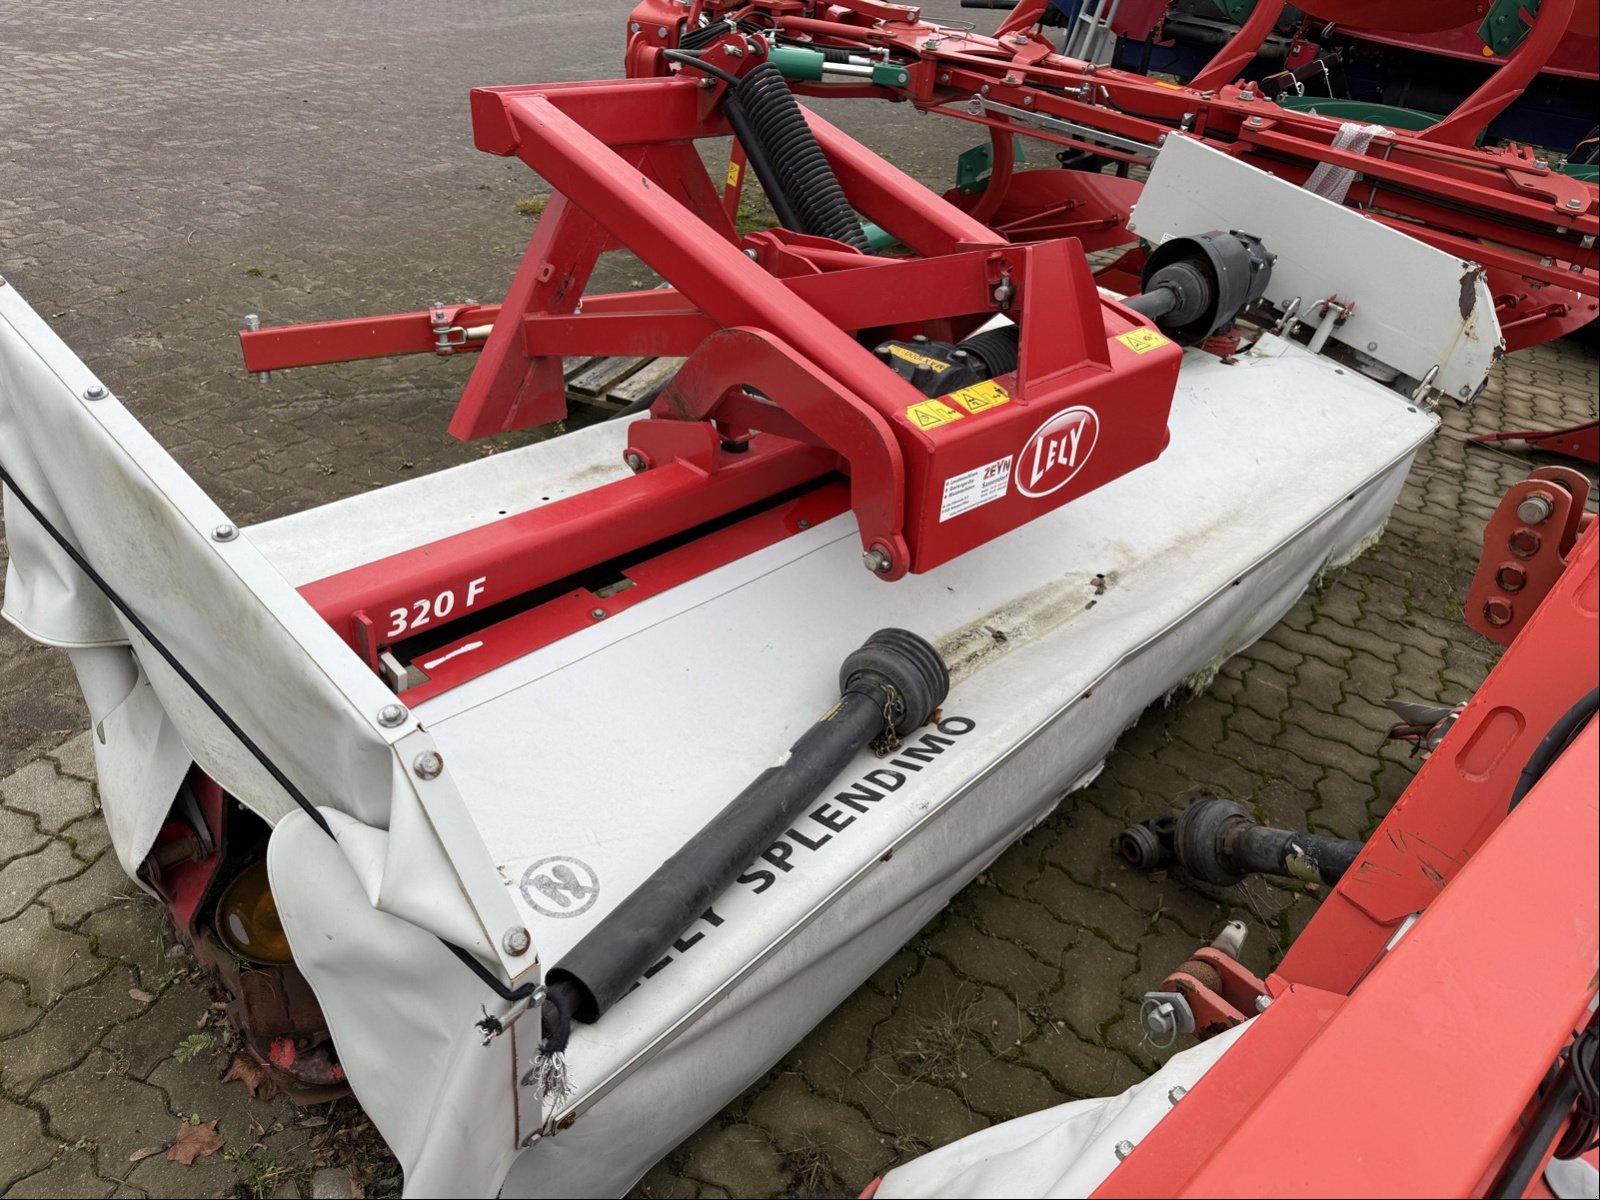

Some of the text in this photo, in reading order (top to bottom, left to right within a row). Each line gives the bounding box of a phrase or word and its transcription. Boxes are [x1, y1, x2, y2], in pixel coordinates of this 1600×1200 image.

[983, 459, 1011, 480] ZEYN
[1029, 416, 1087, 489] LELY
[387, 576, 487, 638] 320 F
[736, 716, 977, 895] SPLENDIMO
